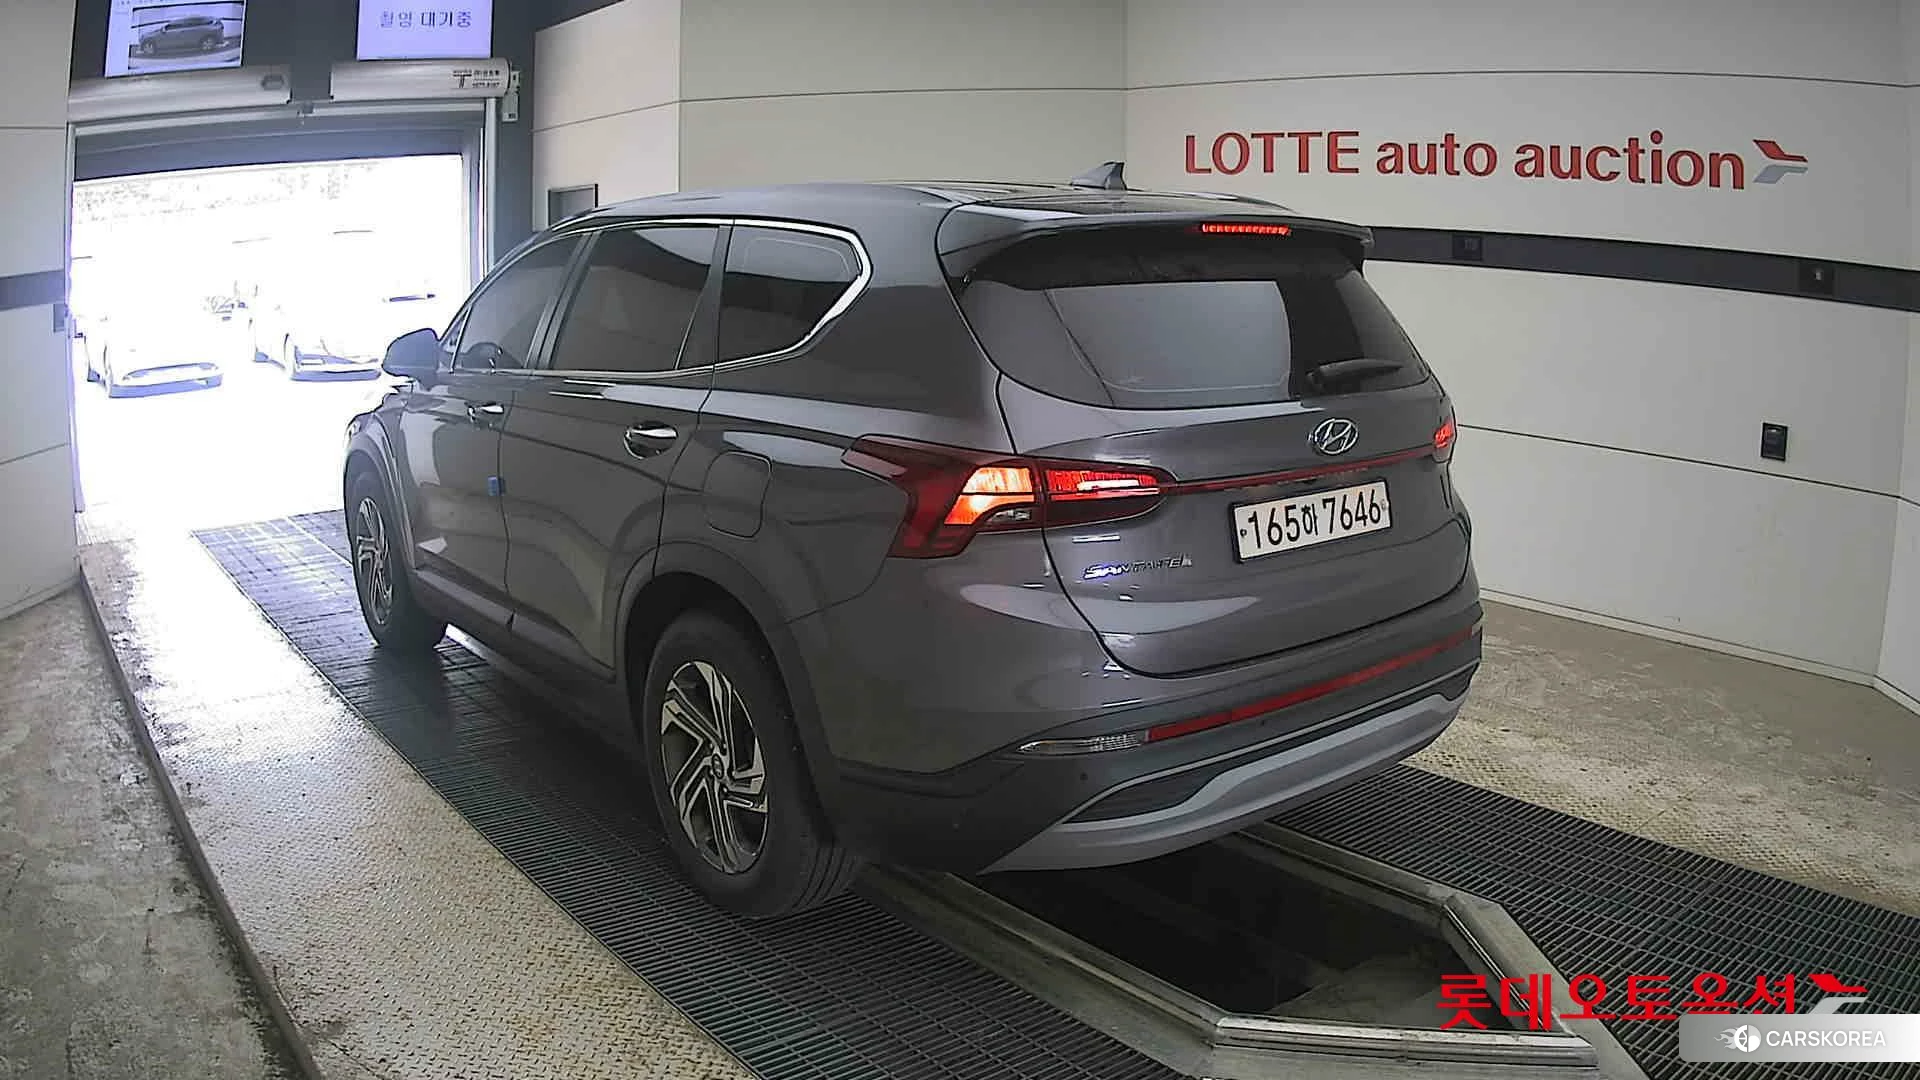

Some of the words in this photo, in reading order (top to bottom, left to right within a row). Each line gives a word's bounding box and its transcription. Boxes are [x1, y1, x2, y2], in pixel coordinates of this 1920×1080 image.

[420, 11, 471, 28] 대기중
[1185, 131, 1360, 174] LOTTE
[1376, 132, 1498, 177] auto
[1514, 130, 1744, 190] auction
[1248, 503, 1318, 549] 165하
[1322, 489, 1381, 534] 7646
